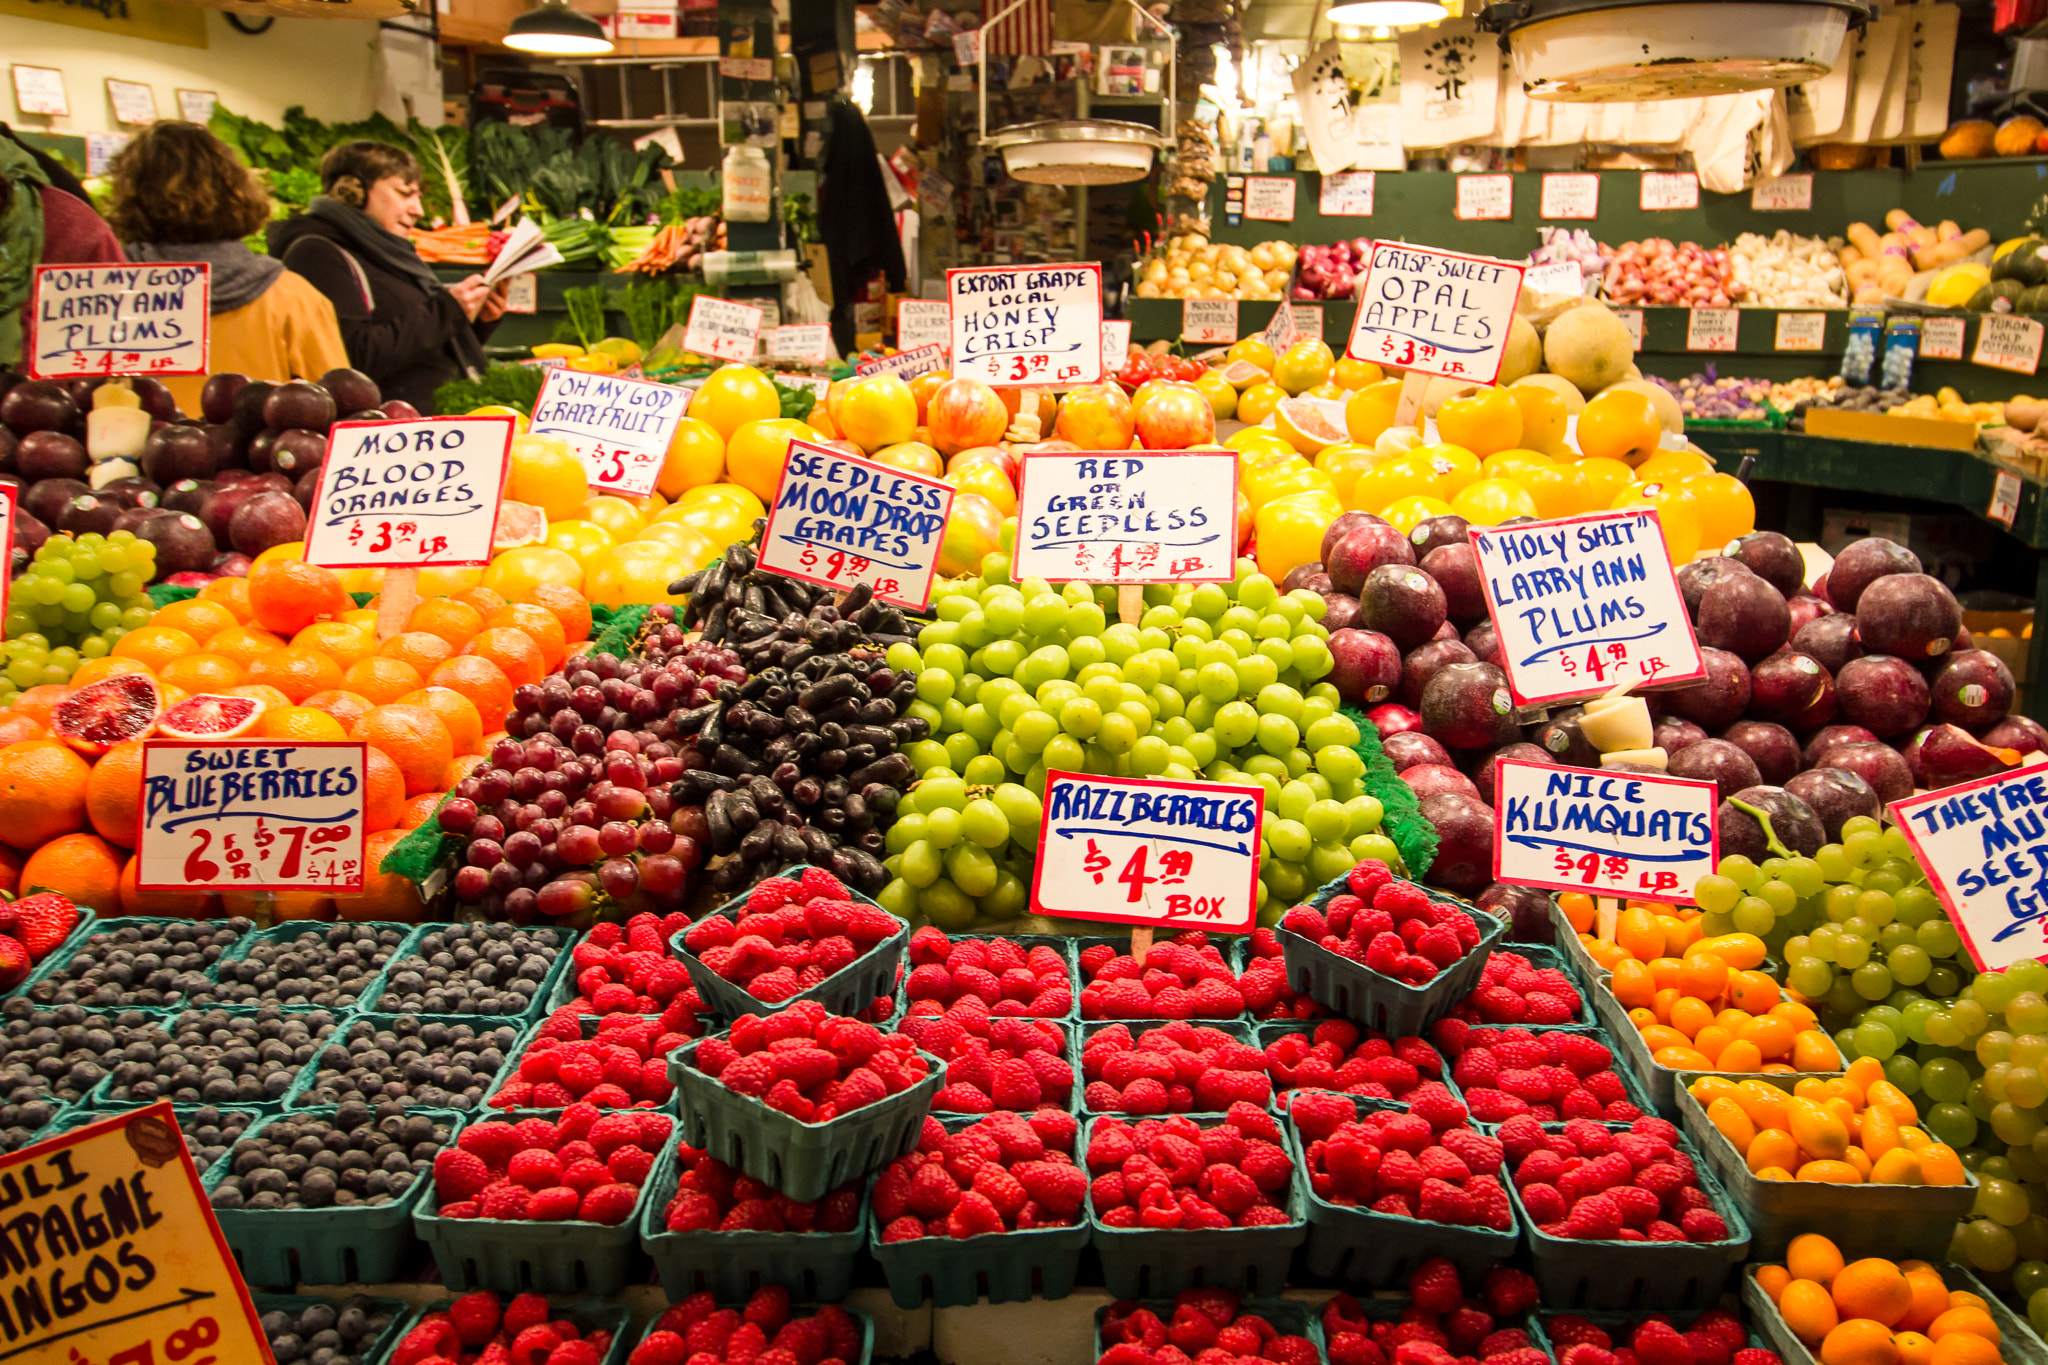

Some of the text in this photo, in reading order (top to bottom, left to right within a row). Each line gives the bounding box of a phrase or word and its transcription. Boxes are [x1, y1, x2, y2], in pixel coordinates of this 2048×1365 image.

[43, 269, 94, 291] "OH
[102, 269, 141, 290] MY
[1374, 249, 1506, 284] CRISP-SWEET
[957, 271, 1087, 295] EXPORT GRADE
[1382, 276, 1480, 310] OPAL
[43, 291, 184, 321] LARRY ANN
[904, 303, 948, 314] ASSORTE
[988, 292, 1056, 308] LOCAL
[58, 318, 182, 350] PLUMS
[902, 330, 948, 340] TOMATOE
[907, 317, 949, 329] CHERR
[964, 306, 1059, 333] HONEY
[1366, 301, 1491, 339] APPLES
[1990, 317, 2030, 332] YUKON
[965, 327, 1056, 354] CRISP
[593, 380, 628, 408] MY
[536, 401, 671, 434] GRAPEFRUIT
[353, 429, 465, 459] MORO
[327, 460, 465, 499] BLOOD
[787, 452, 941, 510] SEEDLESS
[1074, 459, 1144, 479] RED
[330, 483, 474, 515] ORANGES
[1047, 490, 1146, 513] GREEN
[1088, 483, 1121, 494] OR
[776, 481, 945, 545] MOON DROP
[1030, 506, 1208, 540] SEEDLESS
[794, 517, 910, 557] GRAPES
[1479, 515, 1648, 566] "HOLY SHIT"
[1492, 553, 1646, 607] LARRY ANN
[1519, 595, 1645, 645] PLUMS
[184, 747, 297, 773] SWEET
[145, 766, 358, 829] BLUEBERRIES
[1546, 773, 1645, 804] NICE
[1911, 775, 2048, 834] THEY'RE
[1050, 782, 1256, 834] RAZZBERRIES
[1505, 795, 1712, 846] KUMQUATS
[1981, 806, 2048, 860] MU
[184, 828, 220, 882] 2
[1161, 893, 1225, 920] BOX
